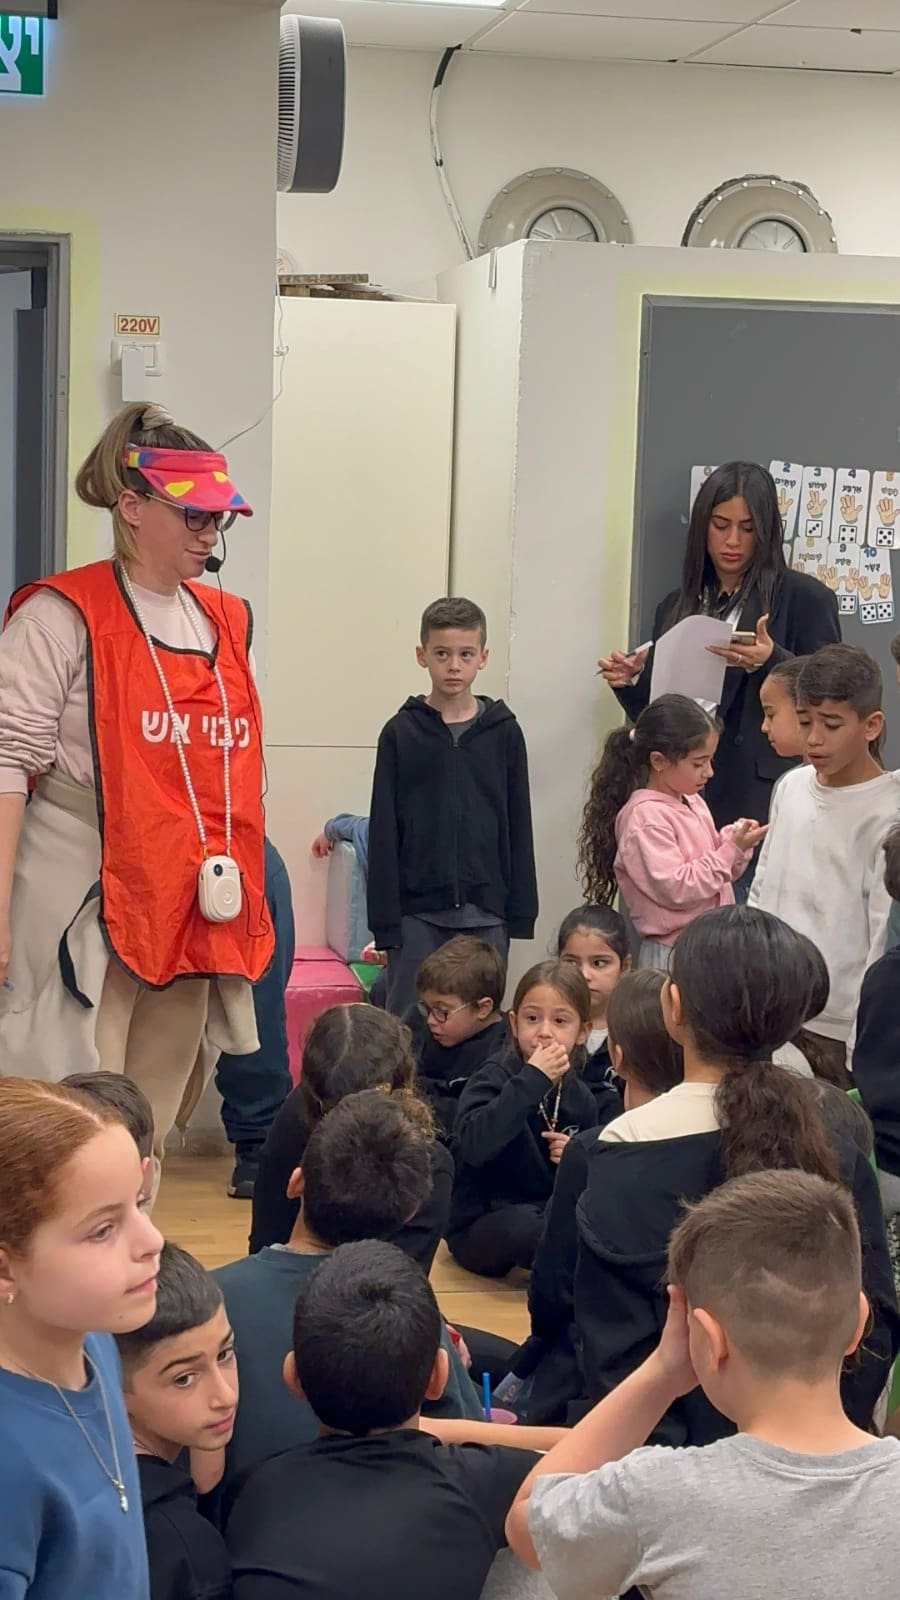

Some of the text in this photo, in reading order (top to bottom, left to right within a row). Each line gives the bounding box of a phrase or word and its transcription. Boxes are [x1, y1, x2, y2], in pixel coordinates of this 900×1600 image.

[120, 317, 157, 333] 220V
[782, 463, 791, 473] 2
[813, 467, 822, 477] 3
[847, 469, 857, 479] 4
[839, 543, 847, 553] 9
[863, 546, 878, 558] 10
[141, 710, 192, 744] אש
